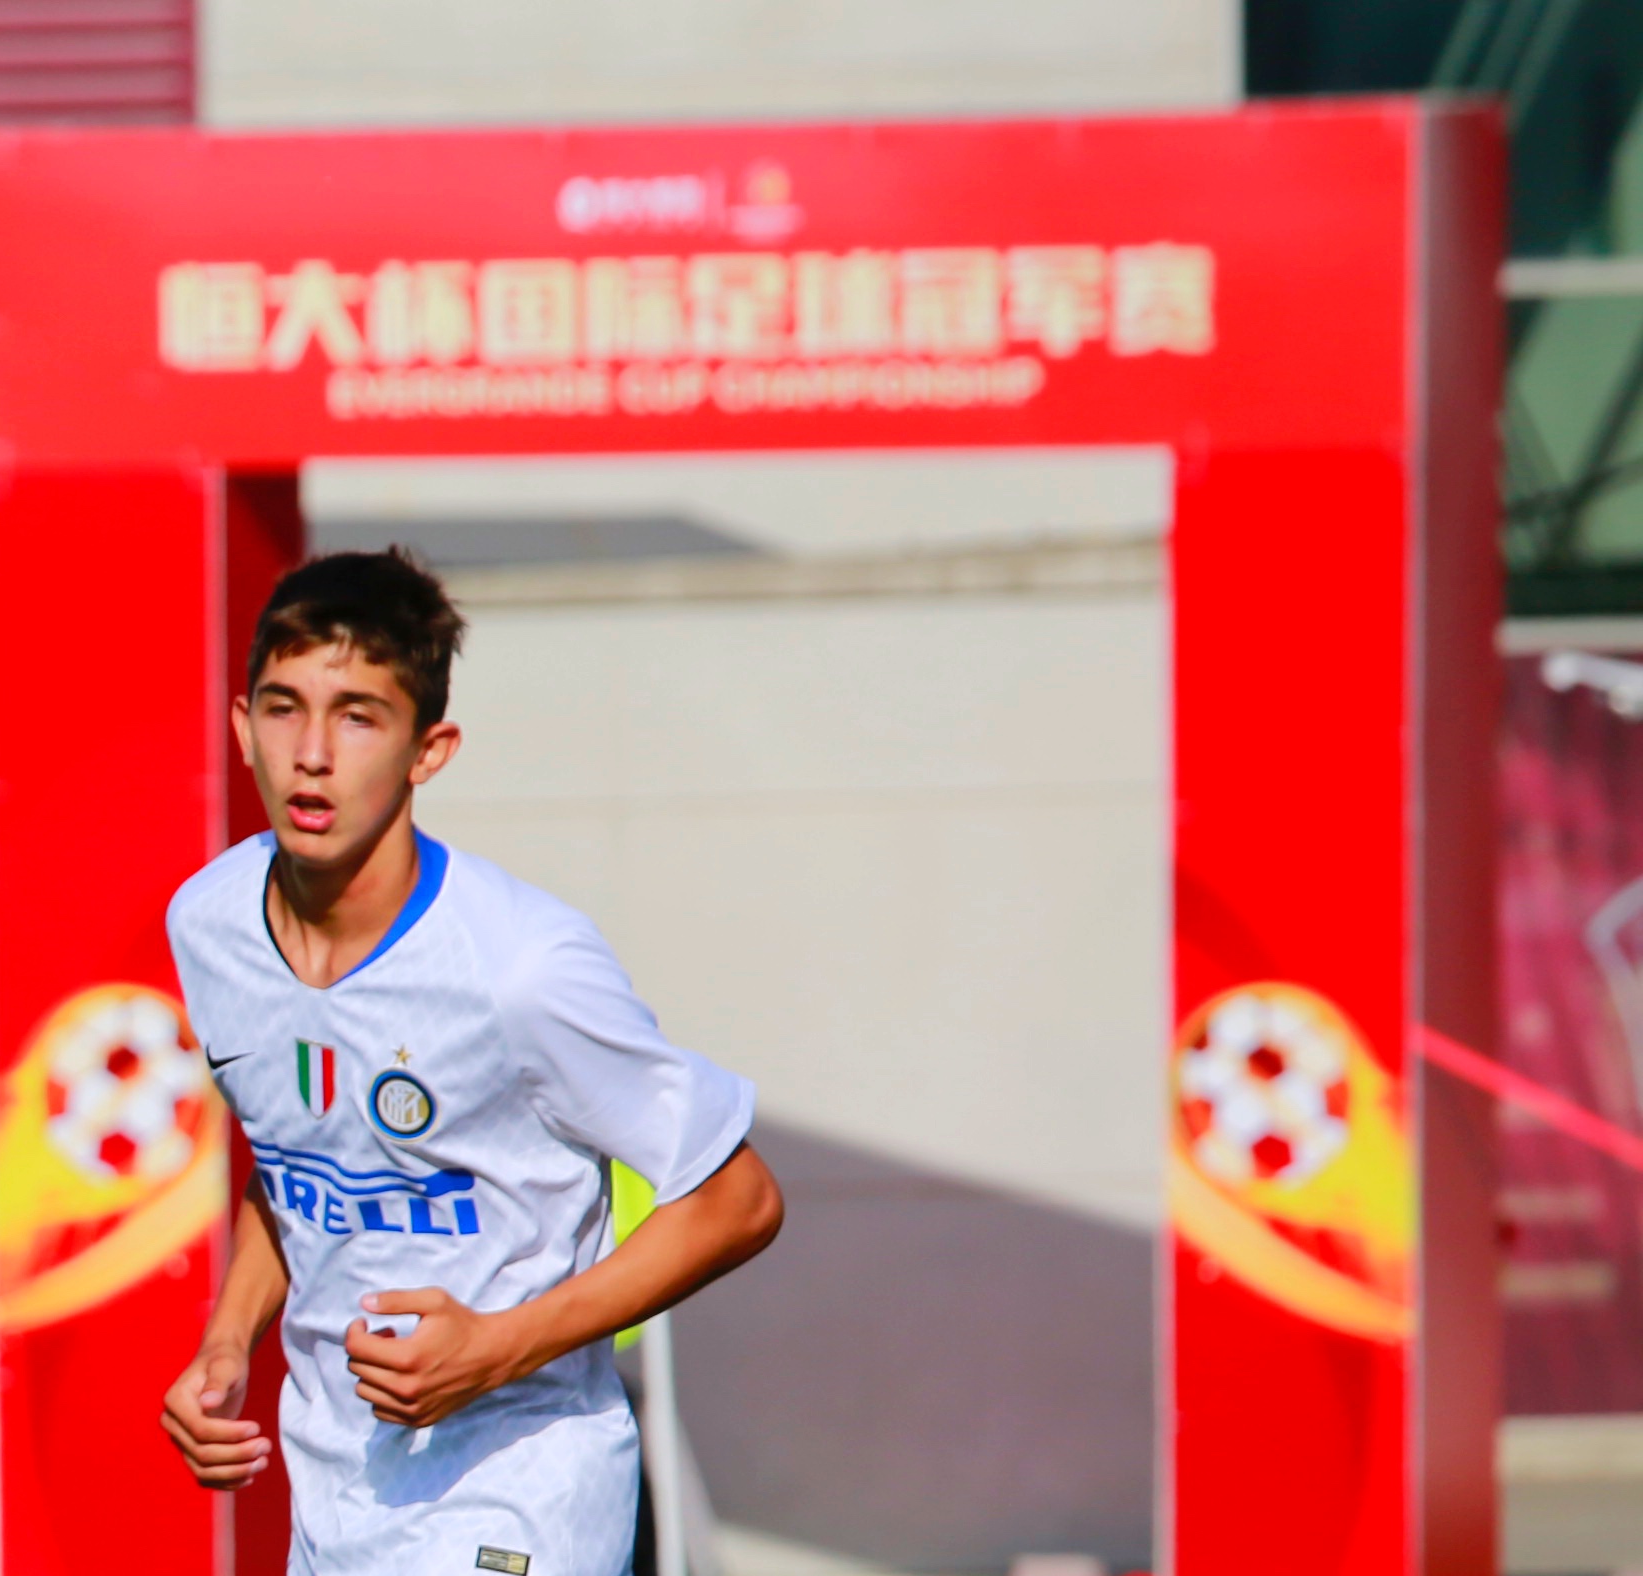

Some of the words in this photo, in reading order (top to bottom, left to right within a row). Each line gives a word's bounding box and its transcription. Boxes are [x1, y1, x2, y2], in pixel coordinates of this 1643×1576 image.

[158, 243, 1214, 371] 恒大杯国际足球冠军赛
[618, 361, 711, 413] CUP
[715, 357, 1045, 412] CHAMPIONSHIP
